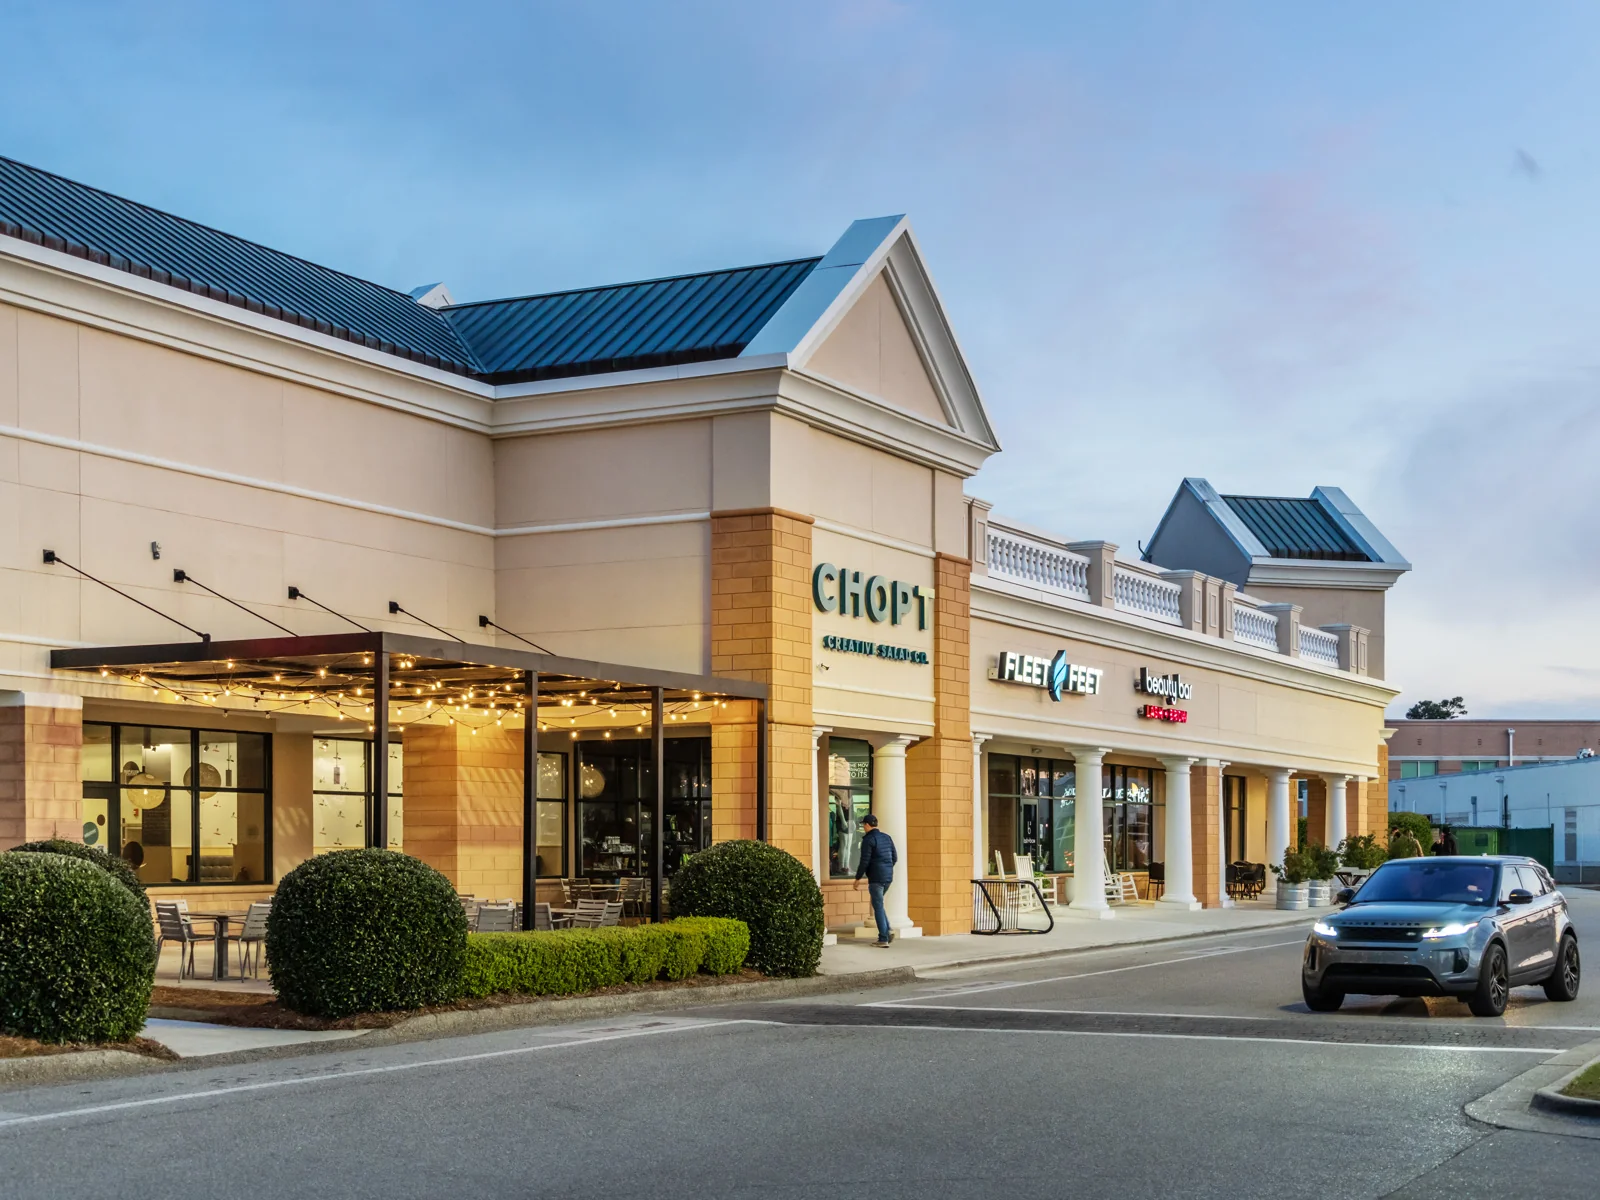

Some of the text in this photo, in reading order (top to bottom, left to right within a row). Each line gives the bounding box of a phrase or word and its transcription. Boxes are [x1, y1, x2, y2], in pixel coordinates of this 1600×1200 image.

[813, 563, 935, 630] CHOPT
[824, 635, 876, 655] CREATIVE
[879, 645, 911, 661] SALAD
[1001, 652, 1103, 694] FLEET FEET
[1142, 667, 1193, 705] beauty bar
